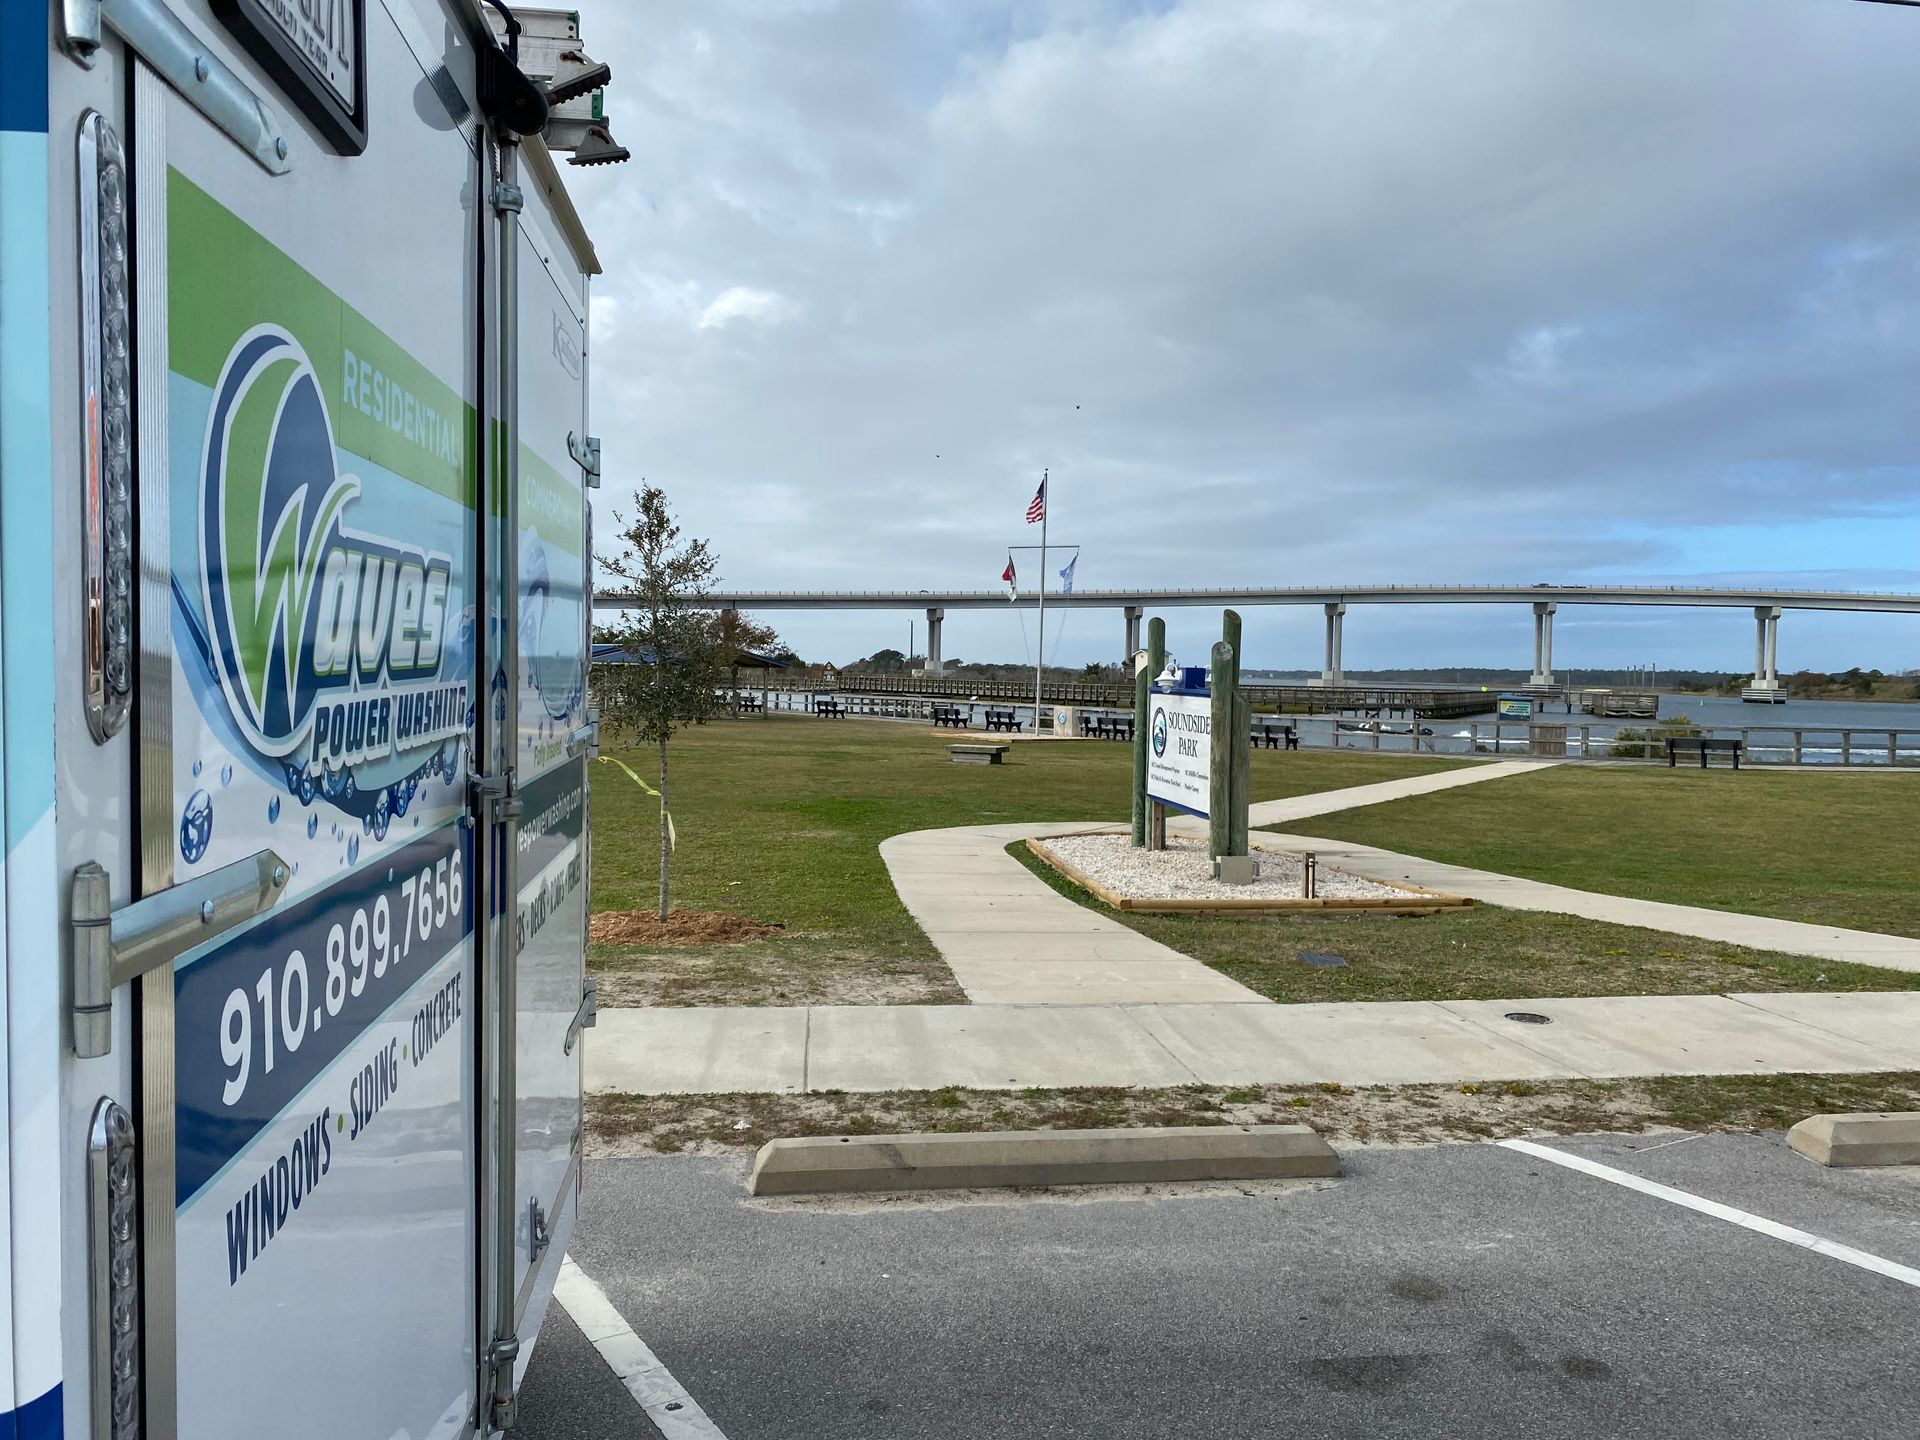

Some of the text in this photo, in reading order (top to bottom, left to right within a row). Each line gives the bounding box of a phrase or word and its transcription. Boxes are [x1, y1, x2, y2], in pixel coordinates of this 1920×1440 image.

[302, 25, 328, 73] YEAR
[344, 349, 459, 467] RESIDENTIAL
[312, 686, 467, 762] POWER WASHING
[1168, 711, 1210, 735] SOUNDSIDE
[1178, 737, 1198, 758] PARK
[220, 848, 462, 1106] 910.899.7656
[226, 971, 462, 1287] WINDOWS SIDING CONCRETE
